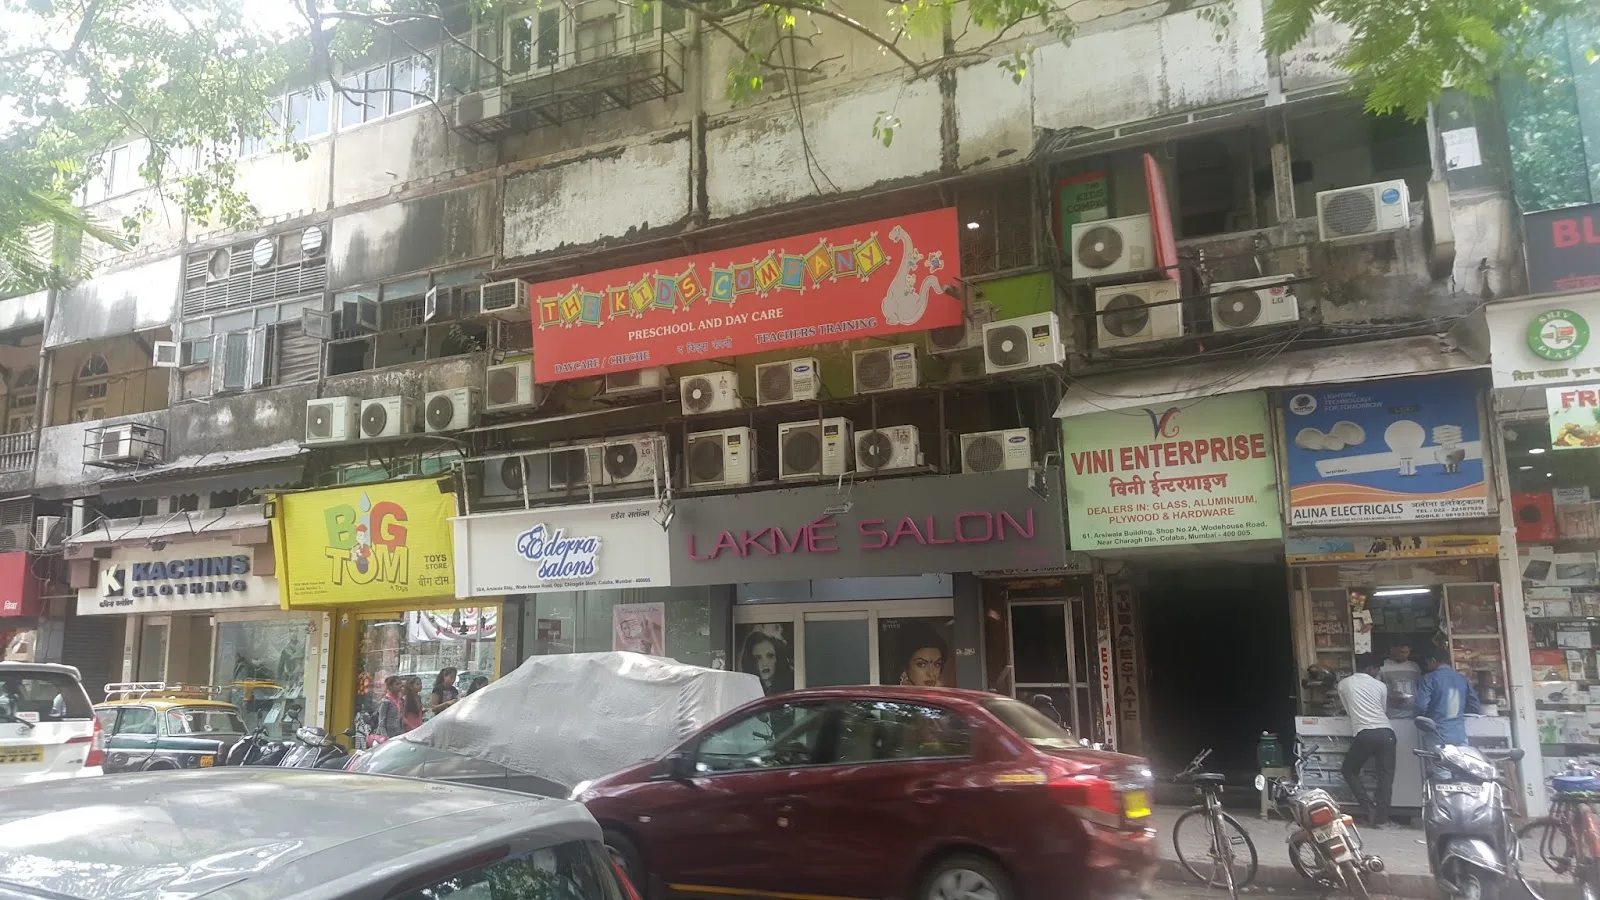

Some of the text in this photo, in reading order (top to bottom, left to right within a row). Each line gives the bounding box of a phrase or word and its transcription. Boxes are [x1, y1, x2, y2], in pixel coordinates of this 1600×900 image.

[542, 242, 883, 323] THE KIDS COMPANY
[628, 308, 784, 341] PRESCHOOL AND DAY CARE
[755, 316, 878, 344] TEACHERS TRAINING
[554, 357, 600, 374] DAYCARE
[608, 351, 650, 367] CRECHE
[1340, 402, 1383, 410] TOMORROW
[1561, 389, 1600, 408] FR
[1071, 433, 1266, 475] VINI ENTERPRISE
[1109, 474, 1145, 497] विनी
[1087, 494, 1258, 516] DEALERS IN: GLASS, ALUMINIUM,
[1109, 507, 1235, 525] PLYWOOD & HARDWARE
[1294, 503, 1404, 519] ALINA ELECTRICALS
[324, 492, 408, 550] BIG
[1123, 527, 1155, 538] Building,
[1156, 527, 1175, 536] Shop
[1201, 522, 1244, 532] Wodehouse
[1245, 519, 1268, 529] Road,
[517, 524, 598, 560] Ederra
[688, 510, 1036, 562] LAKMÉ SALON
[1097, 538, 1113, 546] Near
[1114, 535, 1143, 547] Charagh
[1160, 532, 1187, 542] Colaba,
[1188, 531, 1217, 540] Mumbai
[1222, 529, 1236, 538] 400
[132, 554, 250, 582] KACHINS
[325, 543, 410, 586] TOM
[424, 553, 447, 564] TOYS
[425, 562, 448, 570] STORE
[538, 553, 595, 579] salons
[132, 579, 248, 598] CLOTHING
[1119, 650, 1137, 721] ESTATE
